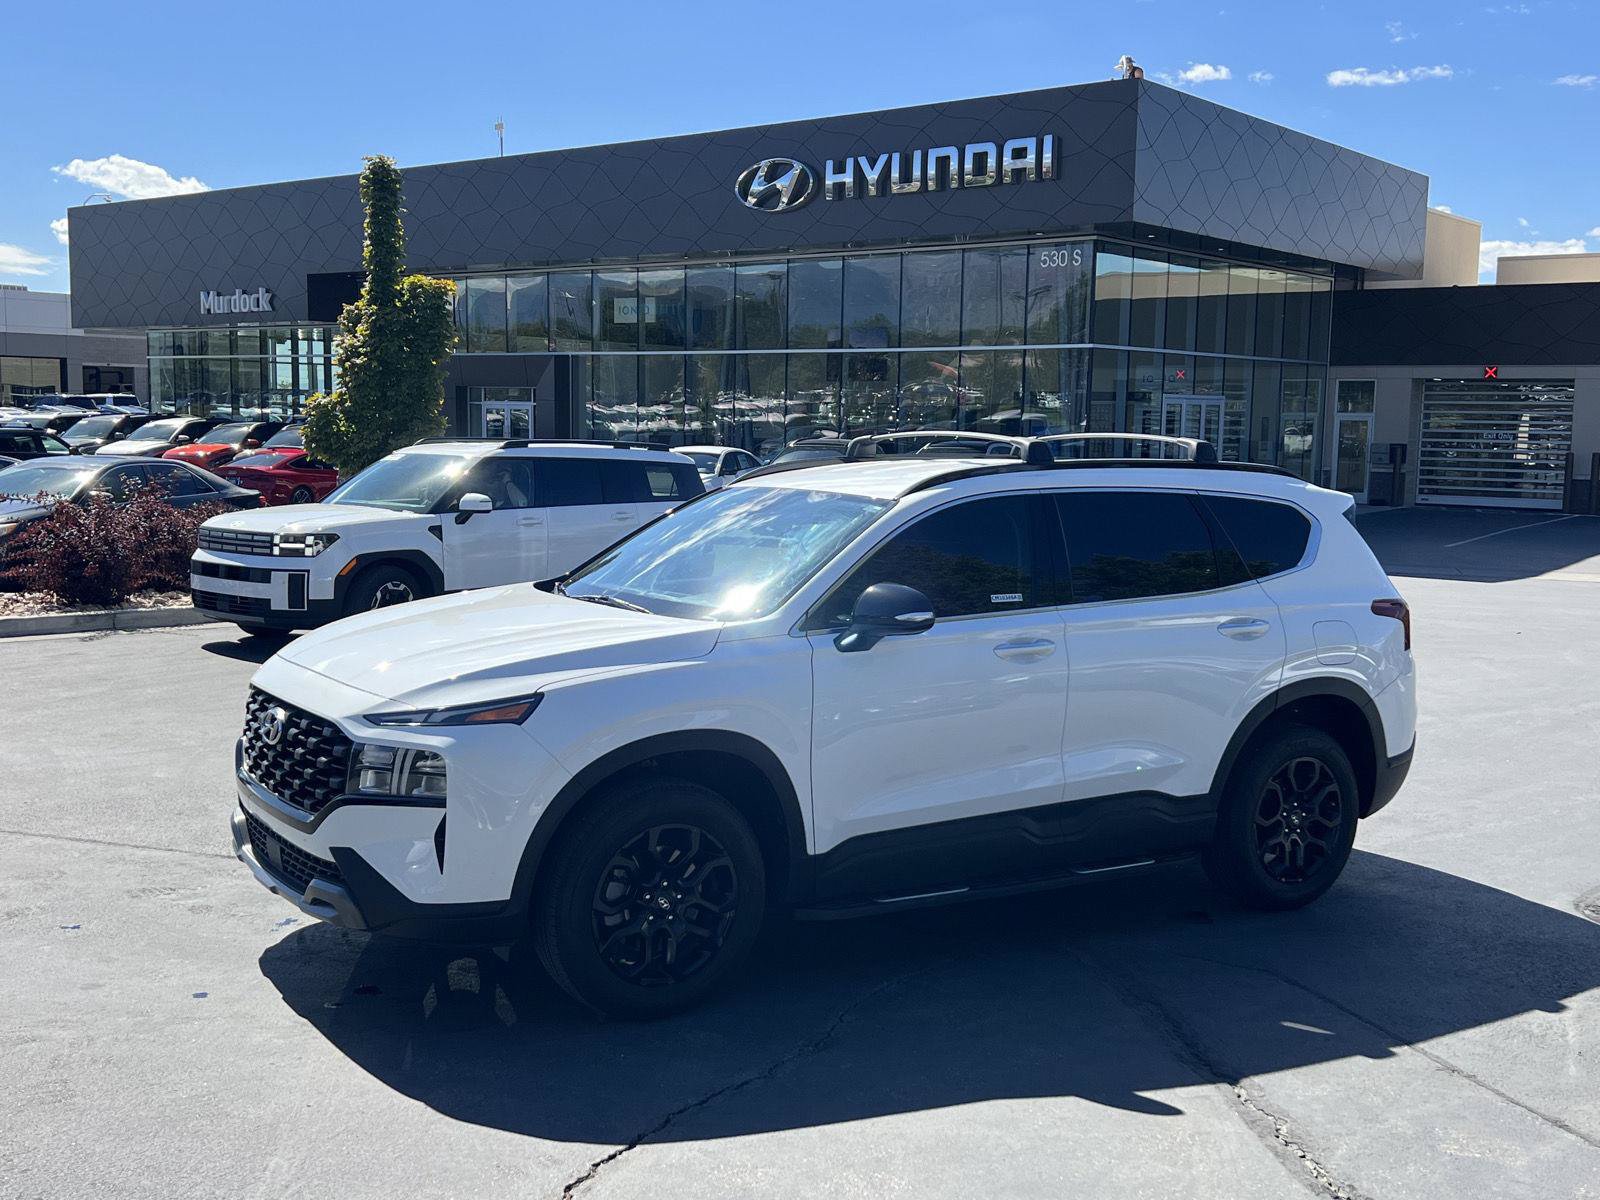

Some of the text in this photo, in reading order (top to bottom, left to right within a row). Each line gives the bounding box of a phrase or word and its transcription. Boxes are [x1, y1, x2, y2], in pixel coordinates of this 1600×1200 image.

[824, 134, 1055, 200] HYUNDAI
[1040, 249, 1082, 268] 530 S
[200, 287, 273, 315] Murdock
